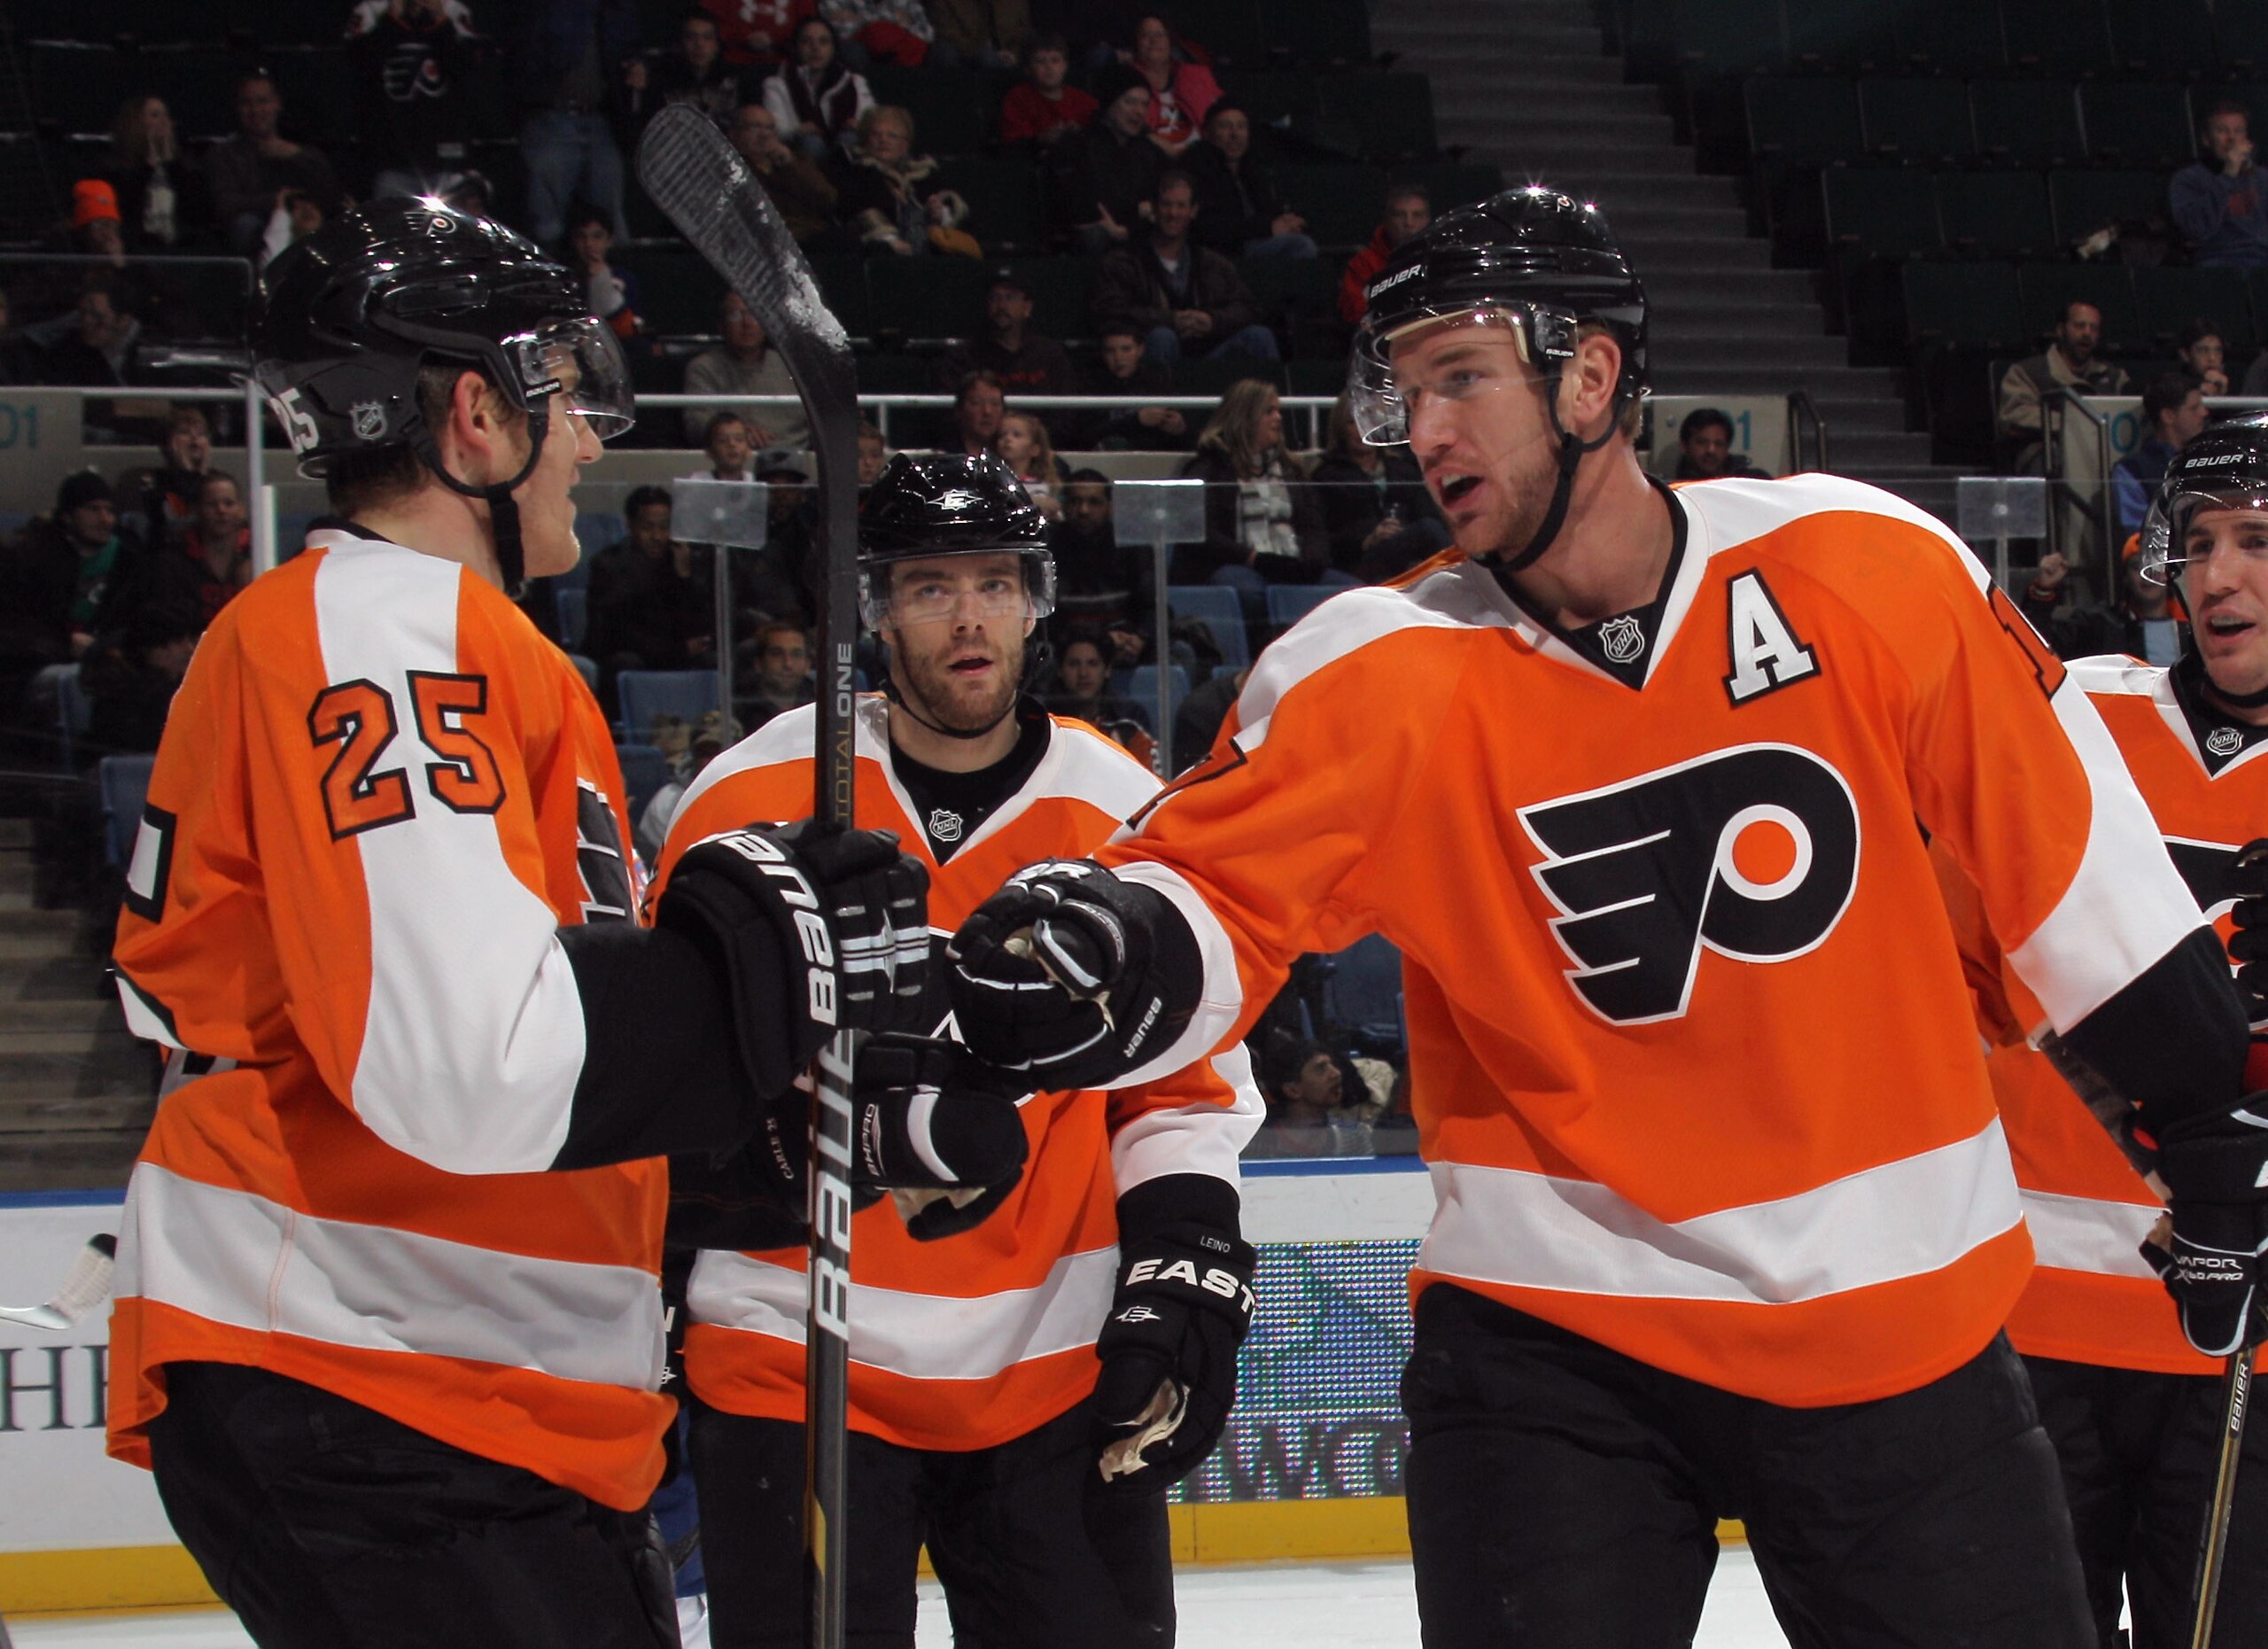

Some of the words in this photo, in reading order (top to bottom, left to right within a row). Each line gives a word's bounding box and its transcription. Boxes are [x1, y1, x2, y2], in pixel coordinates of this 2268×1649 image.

[1722, 566, 1821, 710] A
[307, 670, 507, 844] 25
[1200, 1235, 1231, 1253] LEINO
[2172, 1254, 2242, 1270] VAPOR
[1126, 1258, 1256, 1327] EAST
[2230, 1363, 2249, 1432] BAUER
